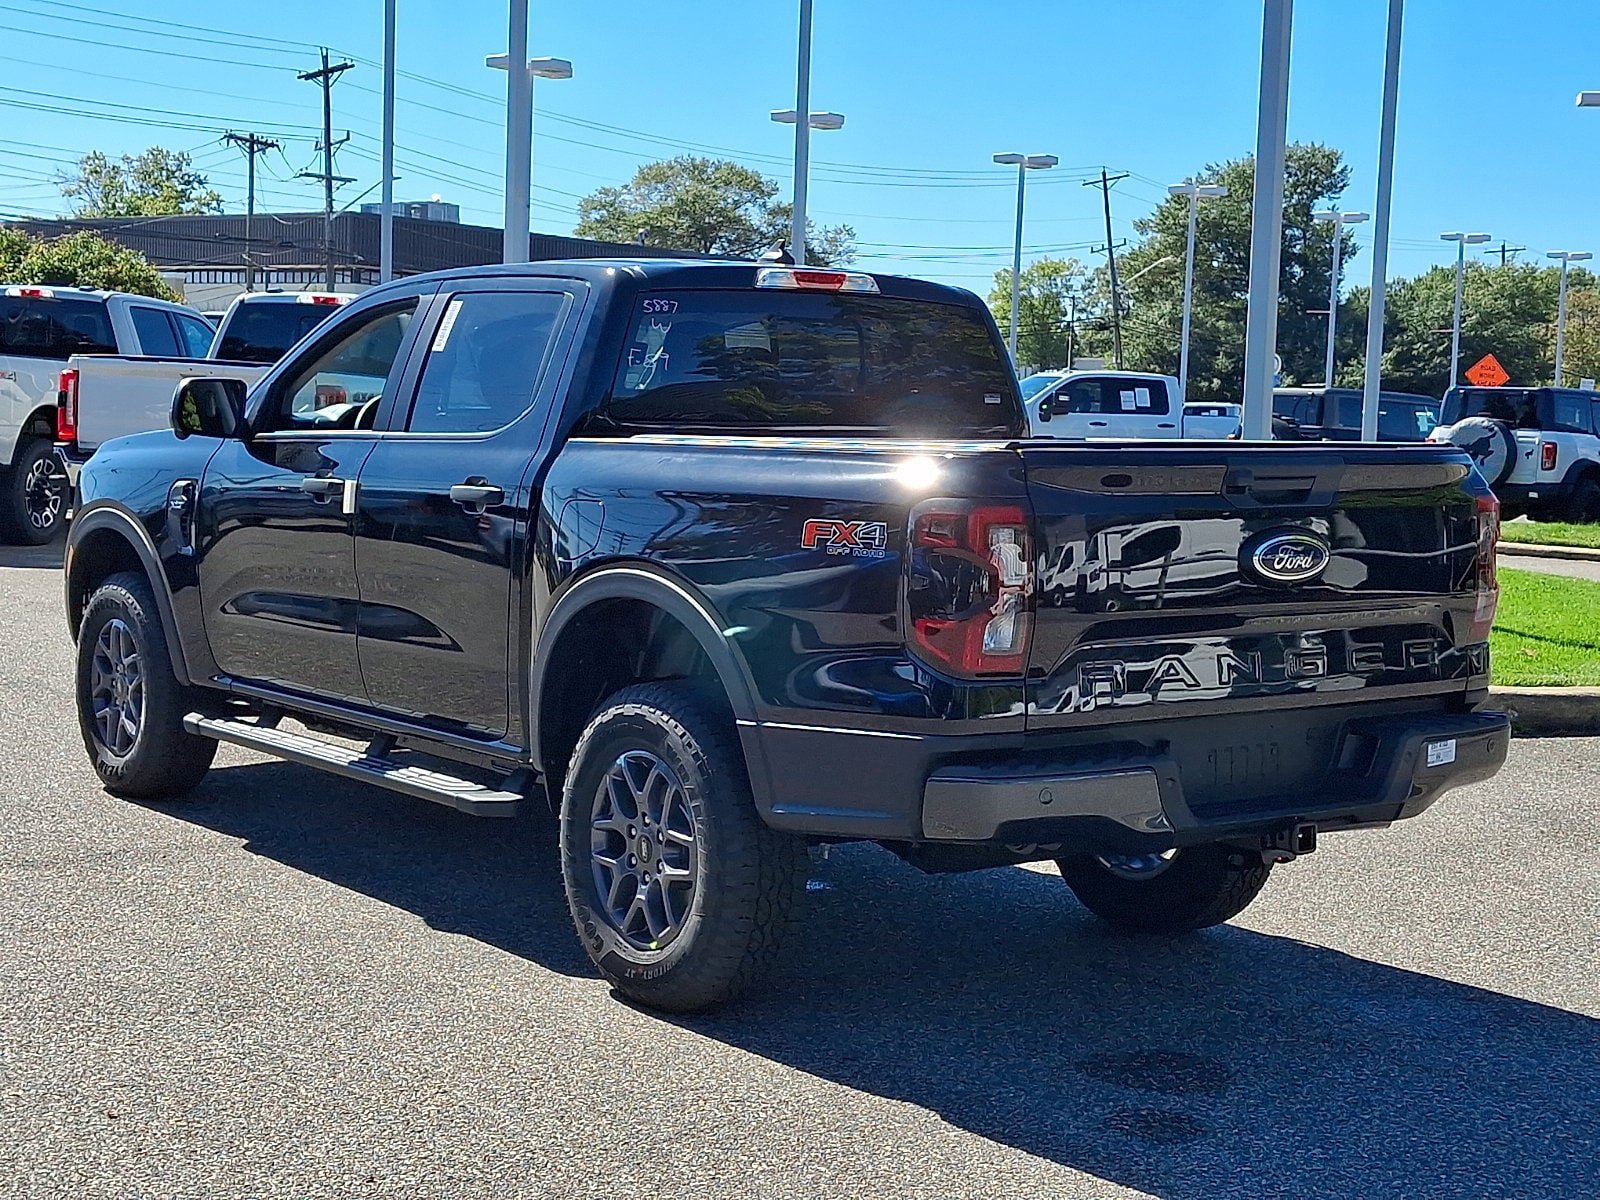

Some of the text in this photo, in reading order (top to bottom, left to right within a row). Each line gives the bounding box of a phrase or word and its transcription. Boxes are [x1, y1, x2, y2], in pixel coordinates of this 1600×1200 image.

[801, 519, 887, 550] FX4
[1262, 544, 1316, 570] Ford
[1077, 638, 1441, 698] RANGER
